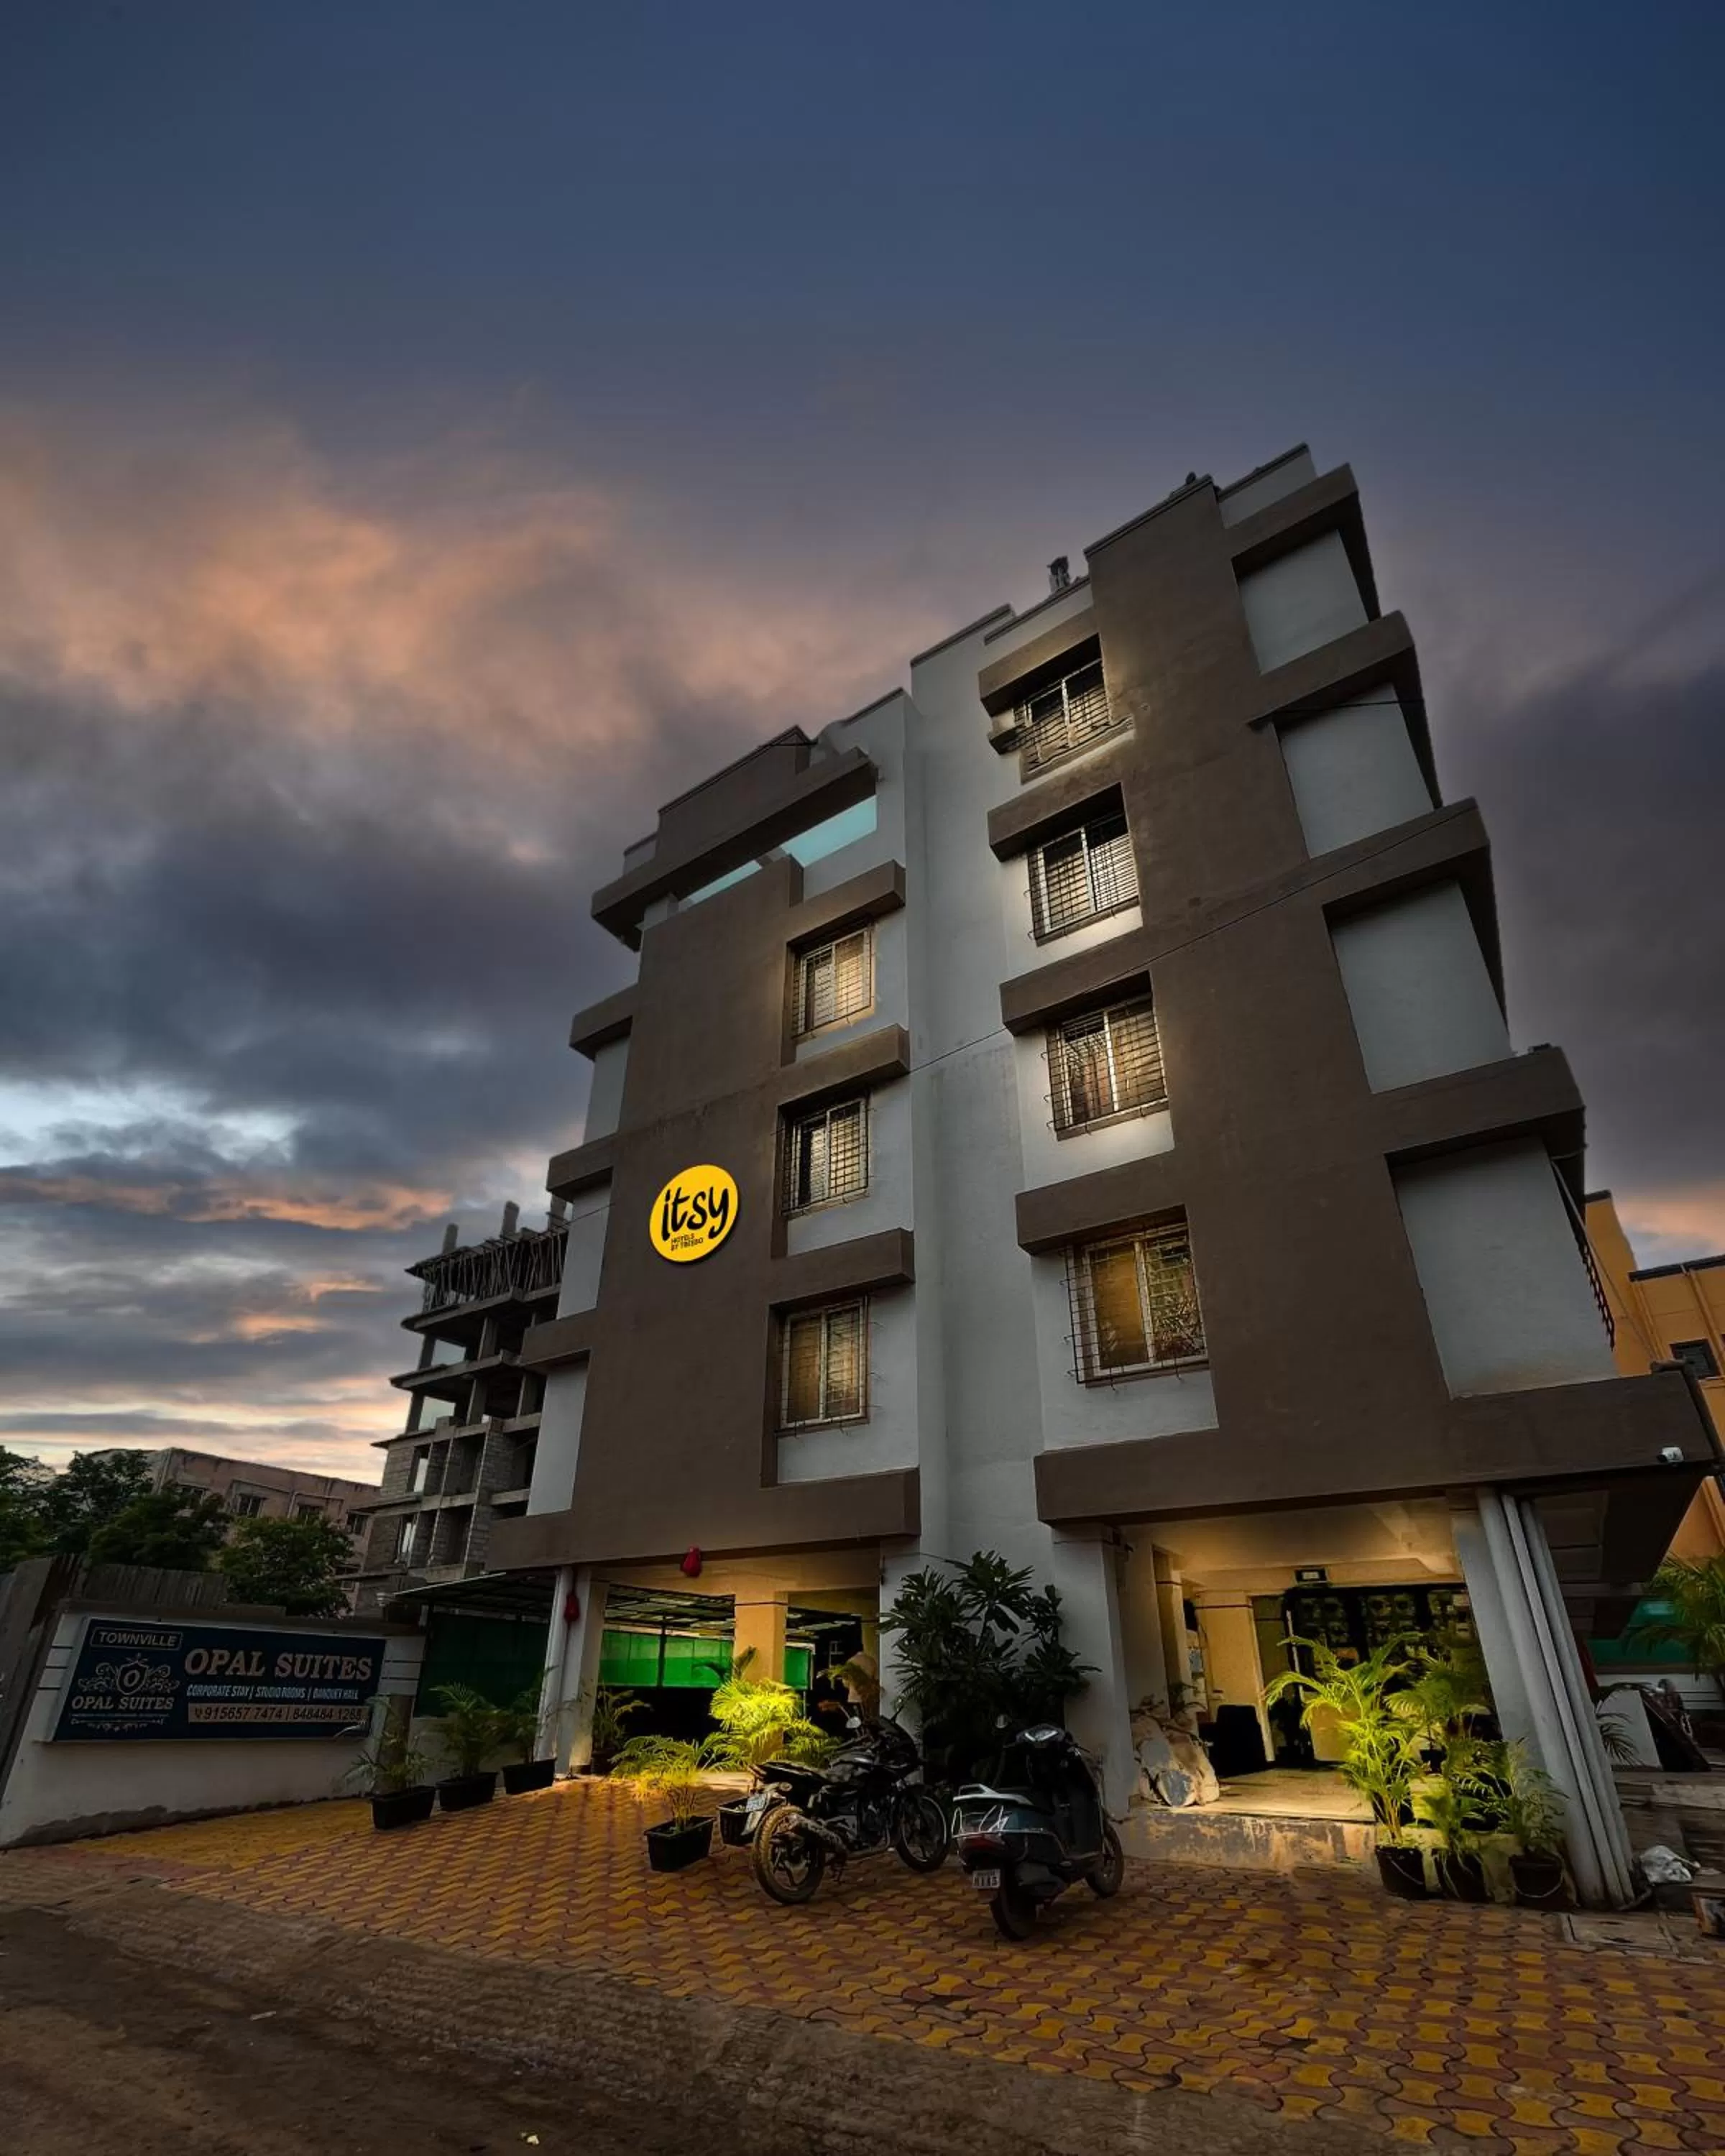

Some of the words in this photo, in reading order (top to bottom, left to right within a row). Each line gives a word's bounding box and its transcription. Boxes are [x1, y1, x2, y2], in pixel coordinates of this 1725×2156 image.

[662, 1186, 729, 1241] itsy
[98, 1631, 178, 1647] TOWNVILLE
[184, 1647, 266, 1677] OPAL
[274, 1651, 374, 1682] SUITES
[186, 1684, 232, 1697] CORPORATE
[231, 1685, 251, 1697] STAY
[71, 1695, 115, 1710] OPAL
[118, 1696, 175, 1710] SUITES
[254, 1707, 282, 1720] 7474
